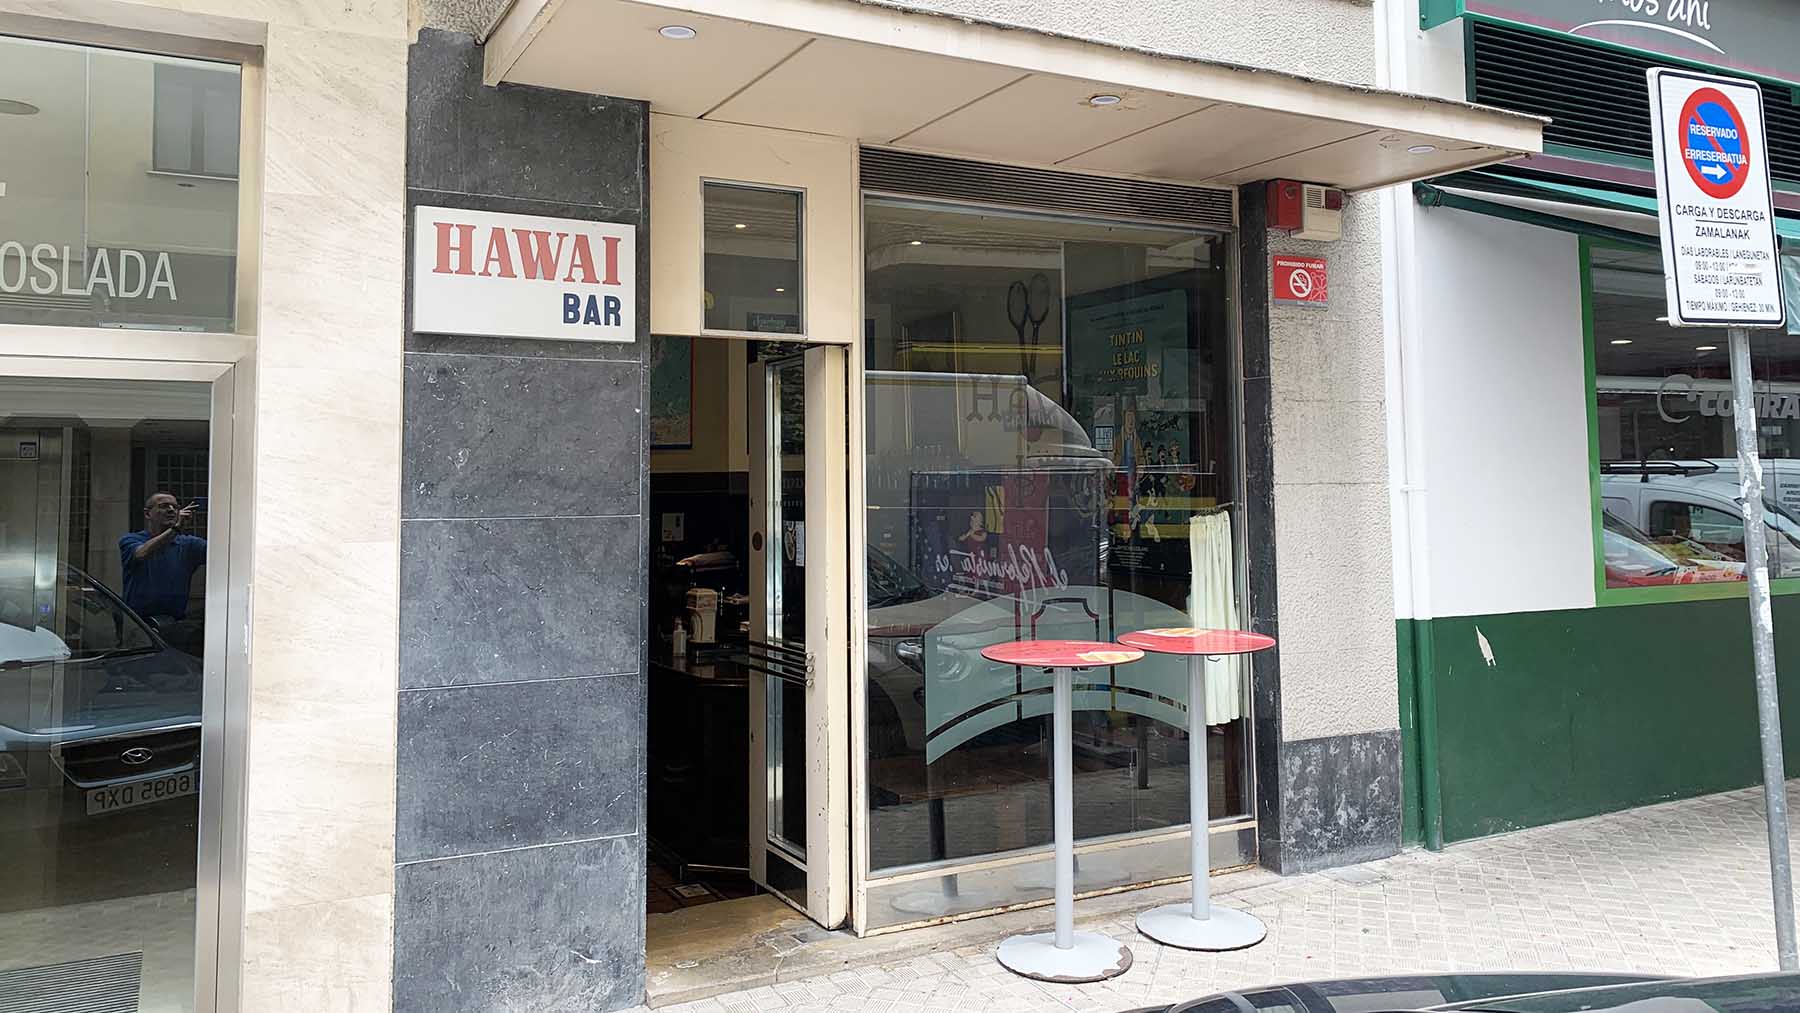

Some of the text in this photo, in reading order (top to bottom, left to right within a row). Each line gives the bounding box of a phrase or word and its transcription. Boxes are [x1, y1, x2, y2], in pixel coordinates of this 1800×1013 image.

[1690, 124, 1738, 140] RESERVADO
[1685, 148, 1748, 165] ERRESERBATUA
[1676, 204, 1765, 221] CARGA Y DESCARGA
[1695, 226, 1750, 240] ZAMALANAK
[433, 222, 622, 286] HAWAI
[1694, 247, 1729, 259] LABORABLES
[563, 293, 621, 327] BAR
[1110, 327, 1144, 347] TINTIN
[1112, 350, 1140, 366] LE LAC
